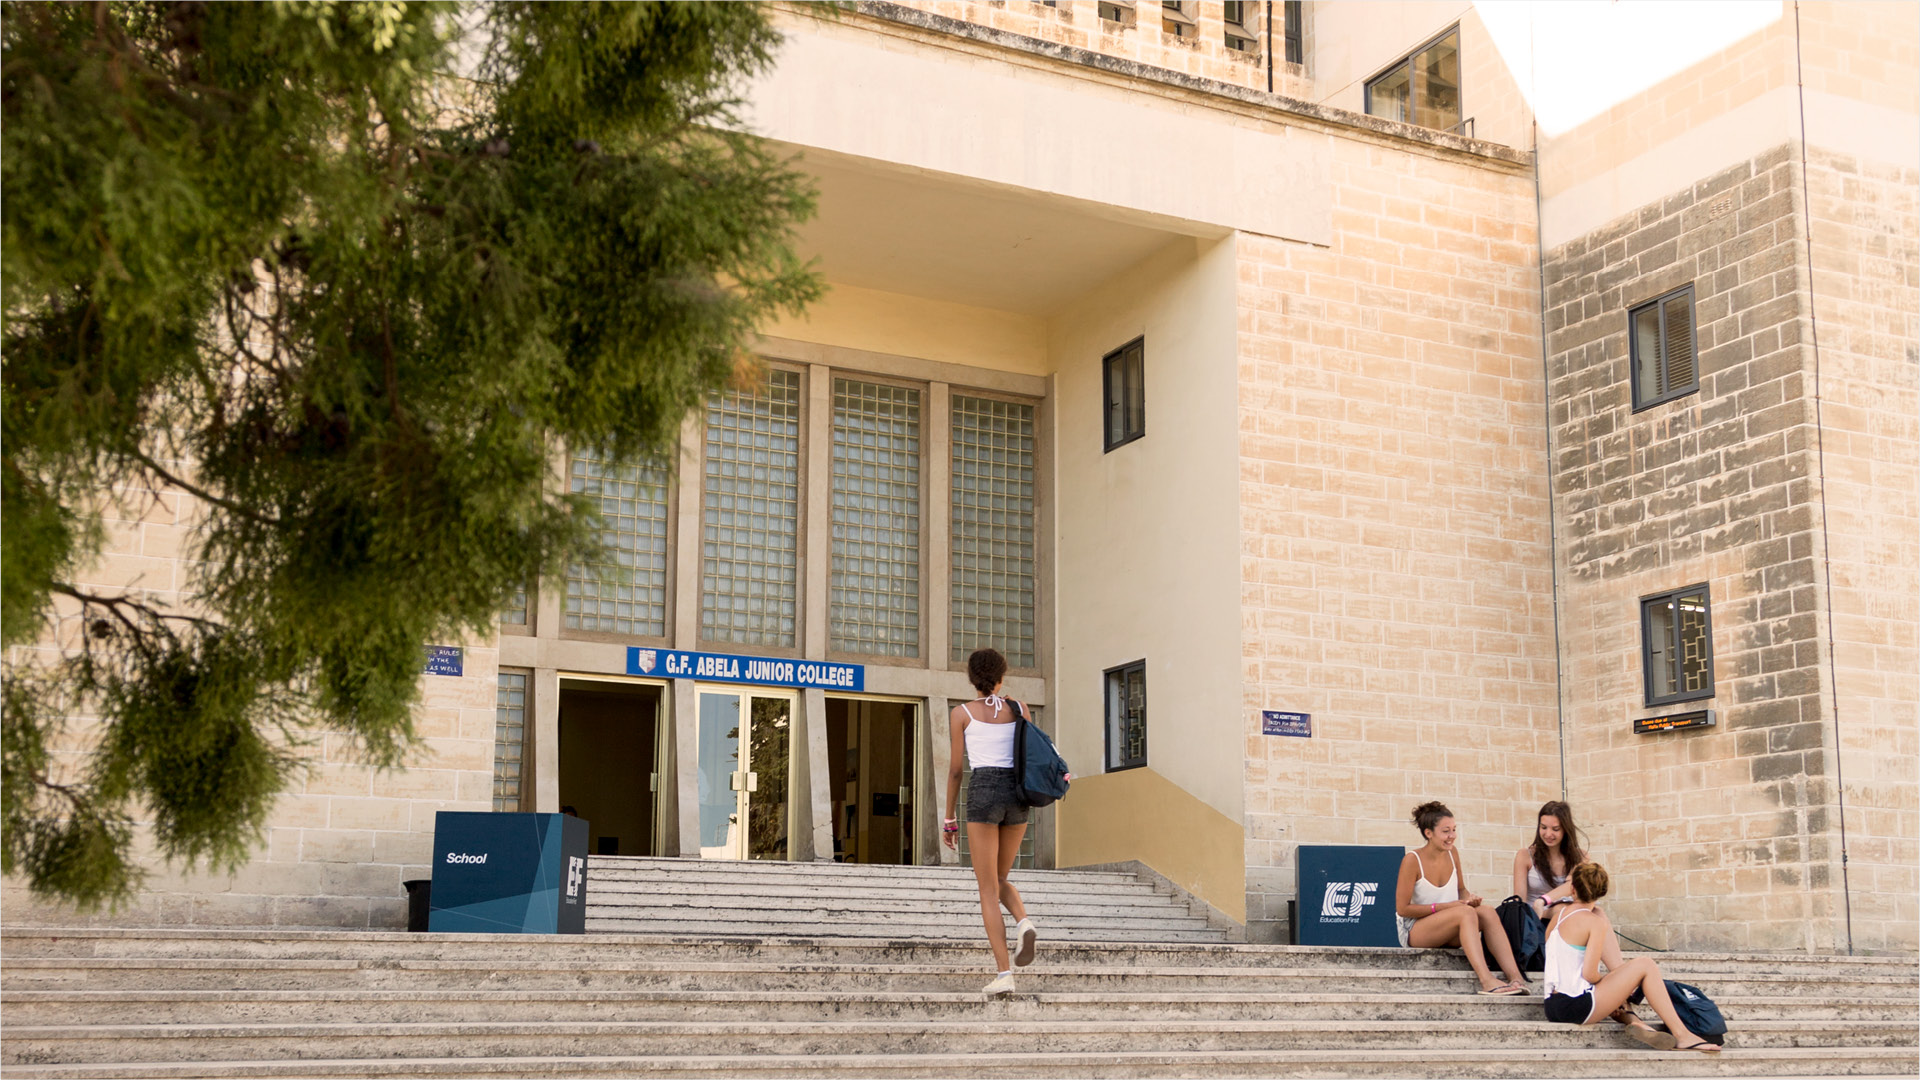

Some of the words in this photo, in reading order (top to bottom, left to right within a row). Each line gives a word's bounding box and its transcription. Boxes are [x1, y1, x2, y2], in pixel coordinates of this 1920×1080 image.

[665, 653, 692, 675] G.F.
[696, 656, 740, 678] ABELA
[745, 660, 794, 682] JUNIOR
[797, 663, 854, 687] COLLEGE
[446, 852, 488, 864] School
[1321, 882, 1379, 916] EF
